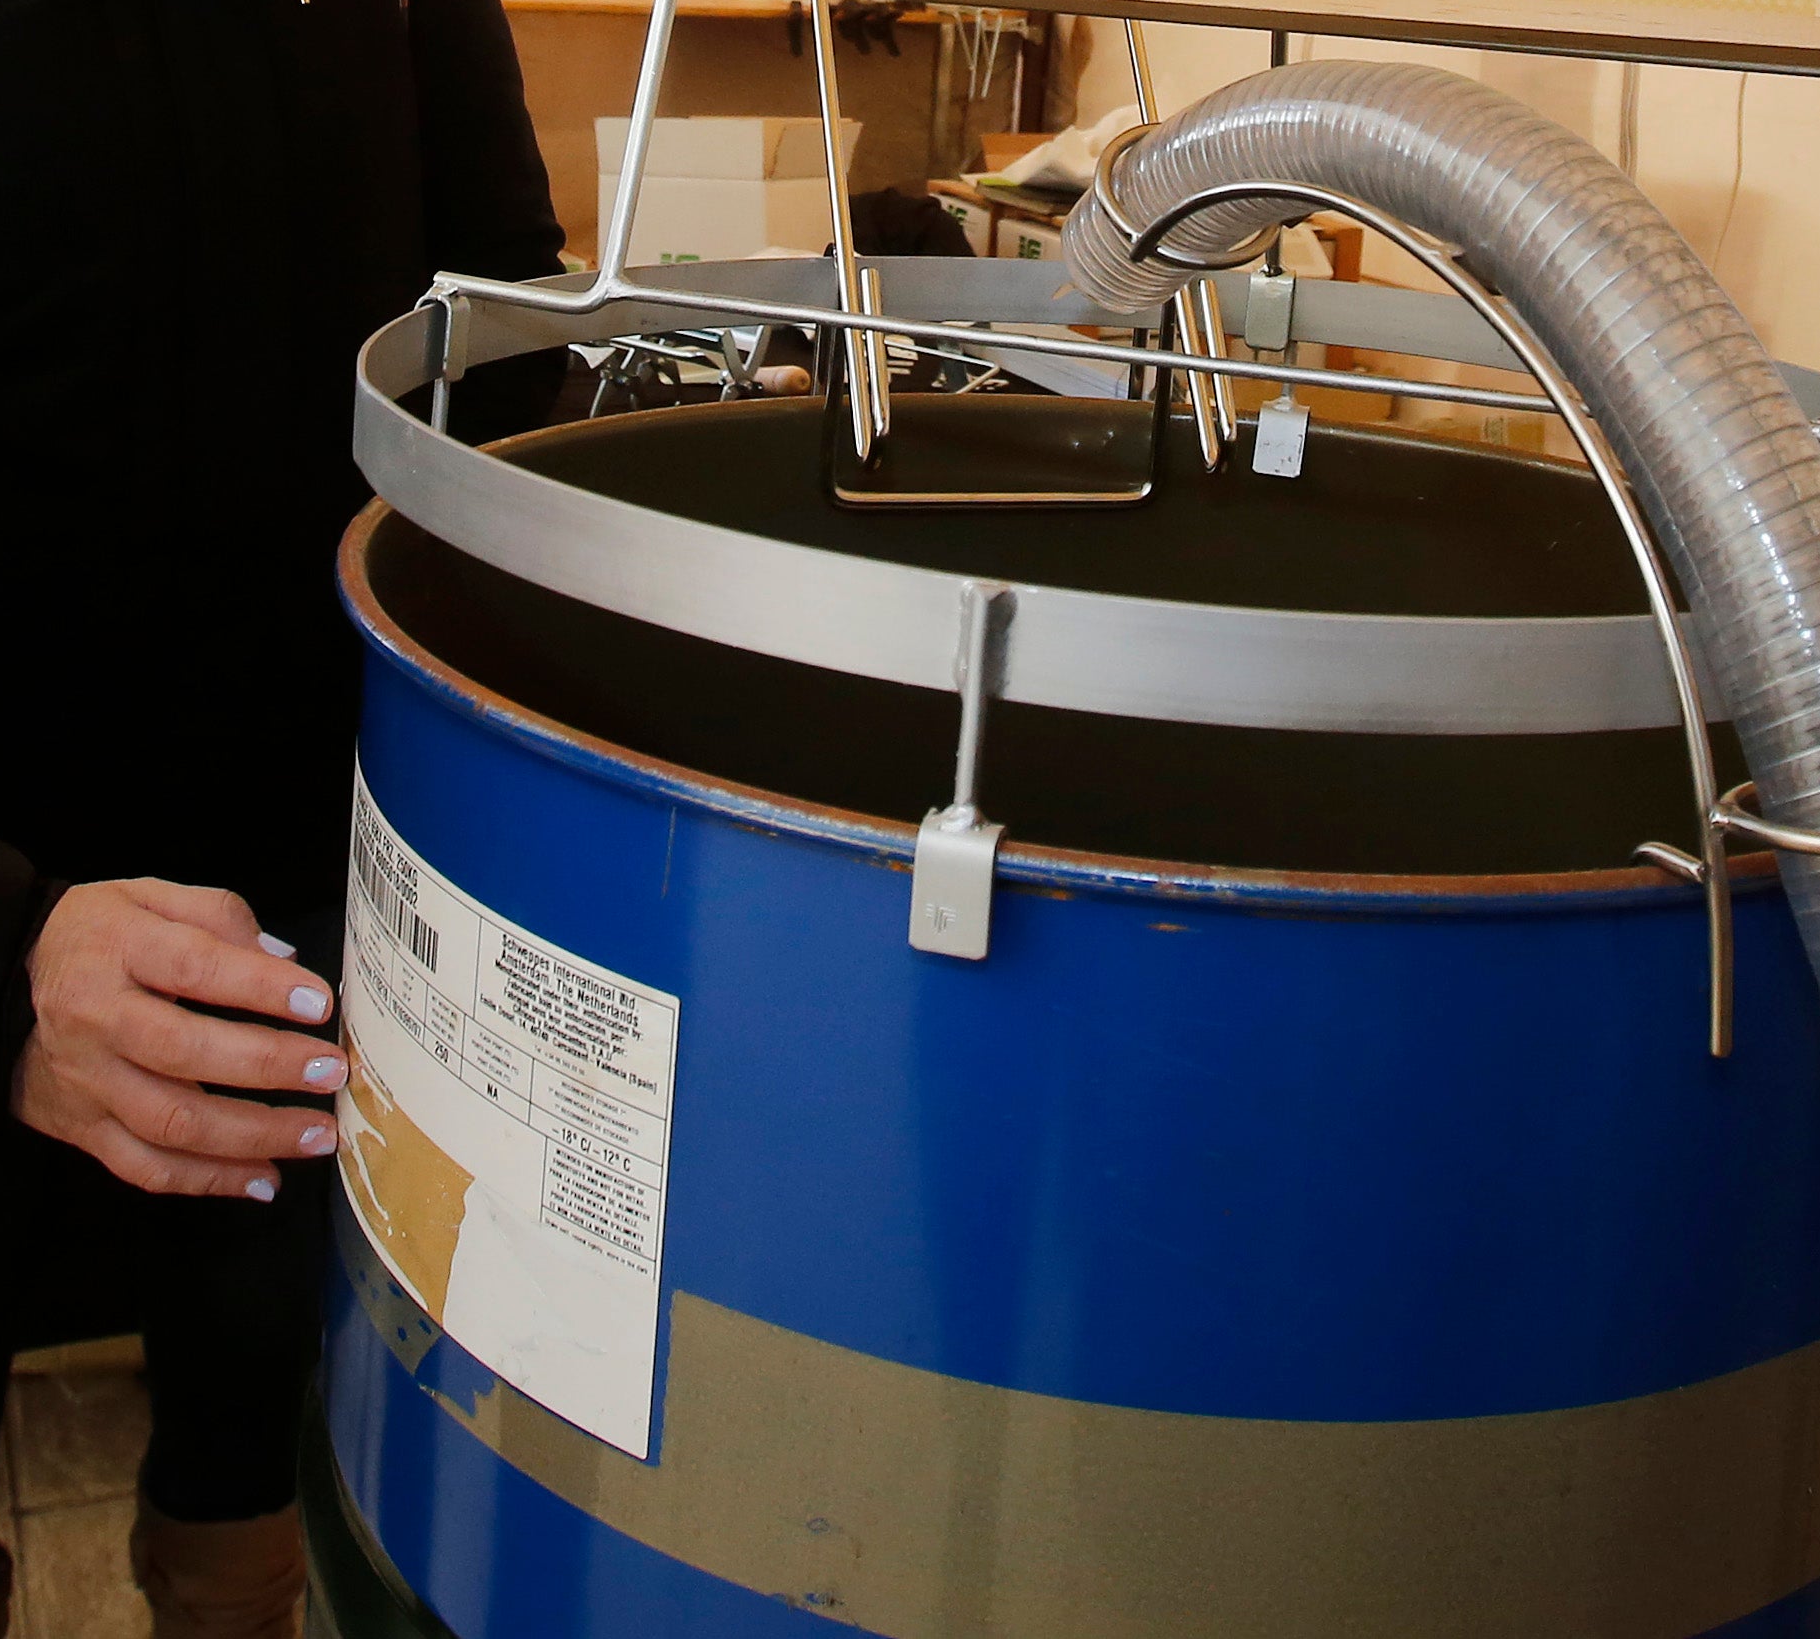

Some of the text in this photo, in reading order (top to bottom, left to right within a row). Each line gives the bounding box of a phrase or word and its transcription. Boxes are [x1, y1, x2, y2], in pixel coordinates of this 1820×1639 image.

[502, 934, 549, 970] Schweppes
[553, 961, 615, 1001] International
[557, 979, 573, 998] The
[578, 989, 639, 1028] Netherlands
[434, 1040, 449, 1063] 250
[595, 1059, 627, 1080] Valencia
[487, 1083, 499, 1100] NA
